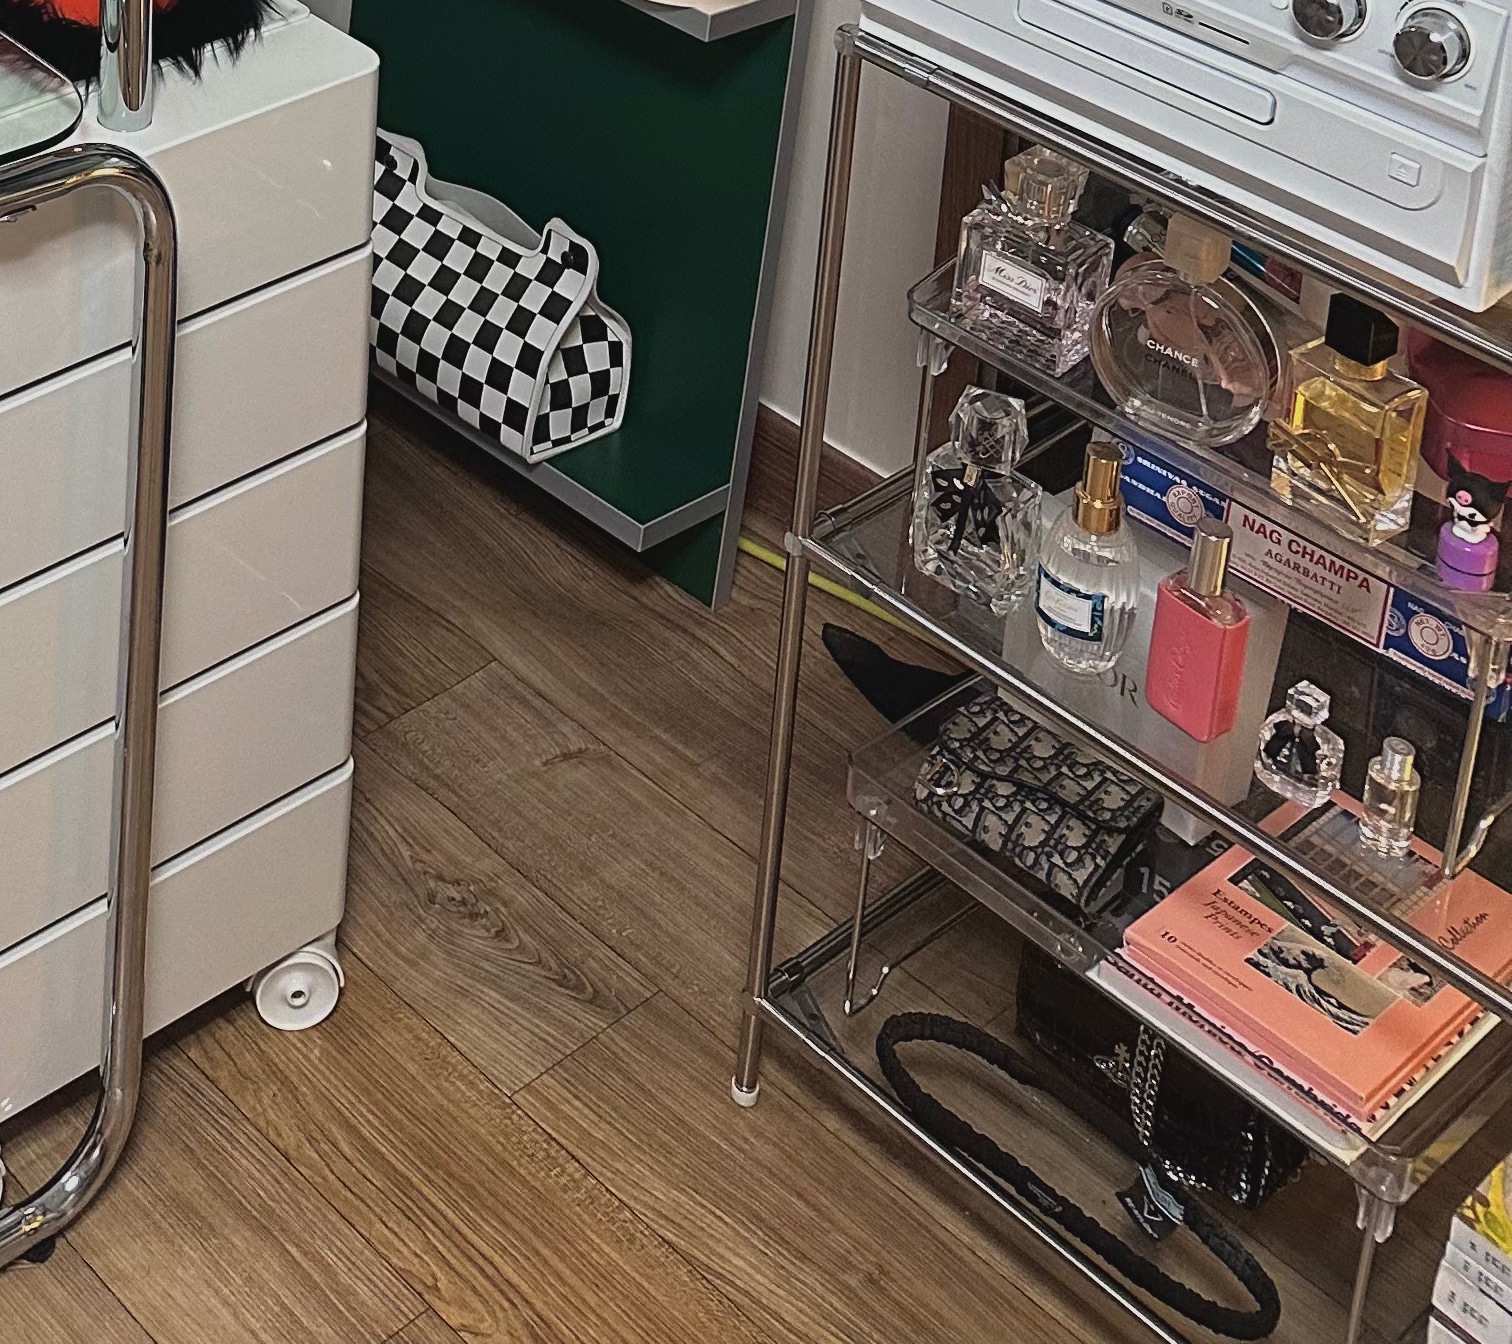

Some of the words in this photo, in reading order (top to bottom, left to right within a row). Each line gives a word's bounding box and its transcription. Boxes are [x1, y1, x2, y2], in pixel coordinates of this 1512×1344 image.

[993, 266, 1015, 282] Miss
[1015, 276, 1037, 294] Dior
[1147, 339, 1199, 368] CHANCE
[1173, 489, 1199, 509] EXPORT
[1242, 514, 1283, 547] NAG
[1288, 539, 1371, 593] CHAMPA
[1264, 548, 1343, 594] AGARBATTI
[1202, 900, 1261, 937] Japanese
[1204, 913, 1243, 940] Prints
[1211, 888, 1275, 934] Estampes
[1160, 930, 1178, 944] 10
[1438, 912, 1489, 950] Collection
